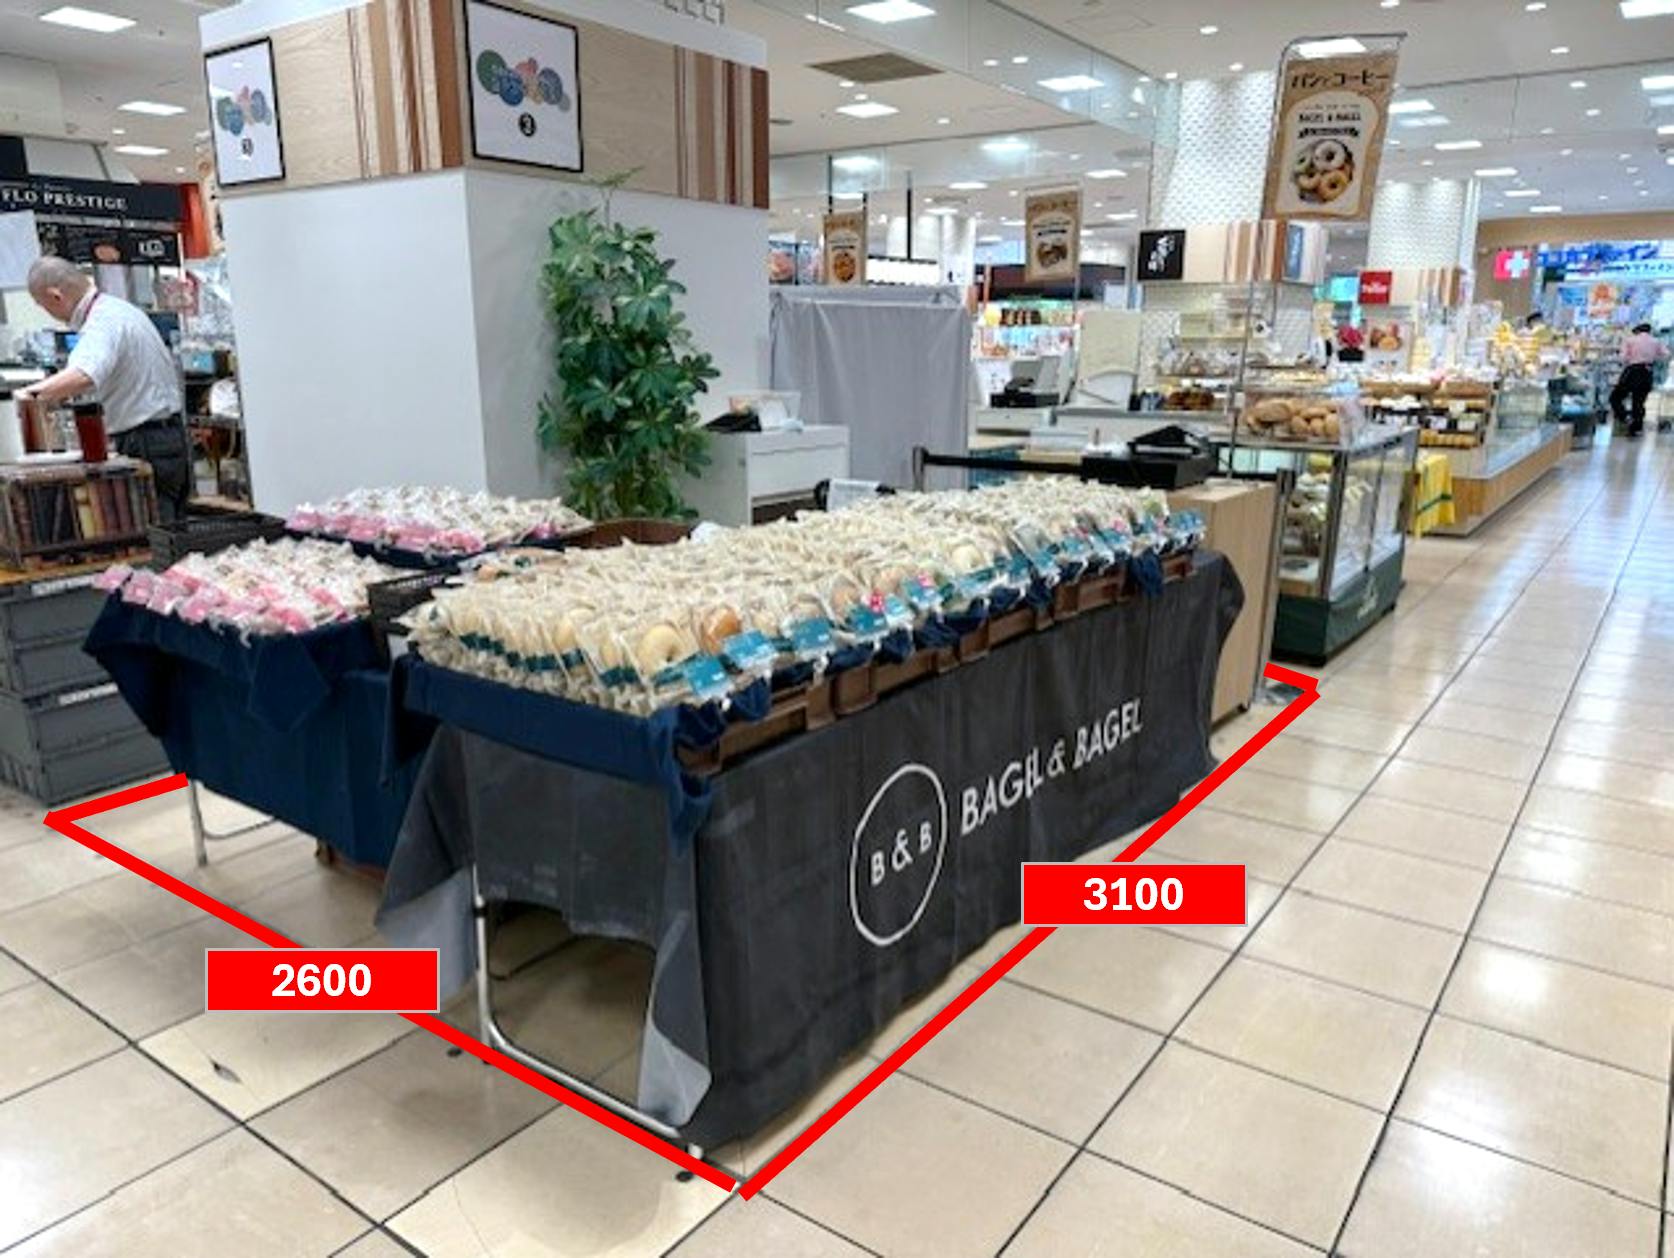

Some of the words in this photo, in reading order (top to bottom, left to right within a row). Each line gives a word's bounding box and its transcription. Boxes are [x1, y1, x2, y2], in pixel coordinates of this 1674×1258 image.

[2, 188, 39, 204] FLO
[43, 191, 128, 211] PRESTIGE
[1047, 738, 1066, 778] &
[1072, 698, 1142, 770] BAGEL
[870, 850, 885, 886] B
[891, 829, 913, 871] &
[919, 821, 932, 854] B
